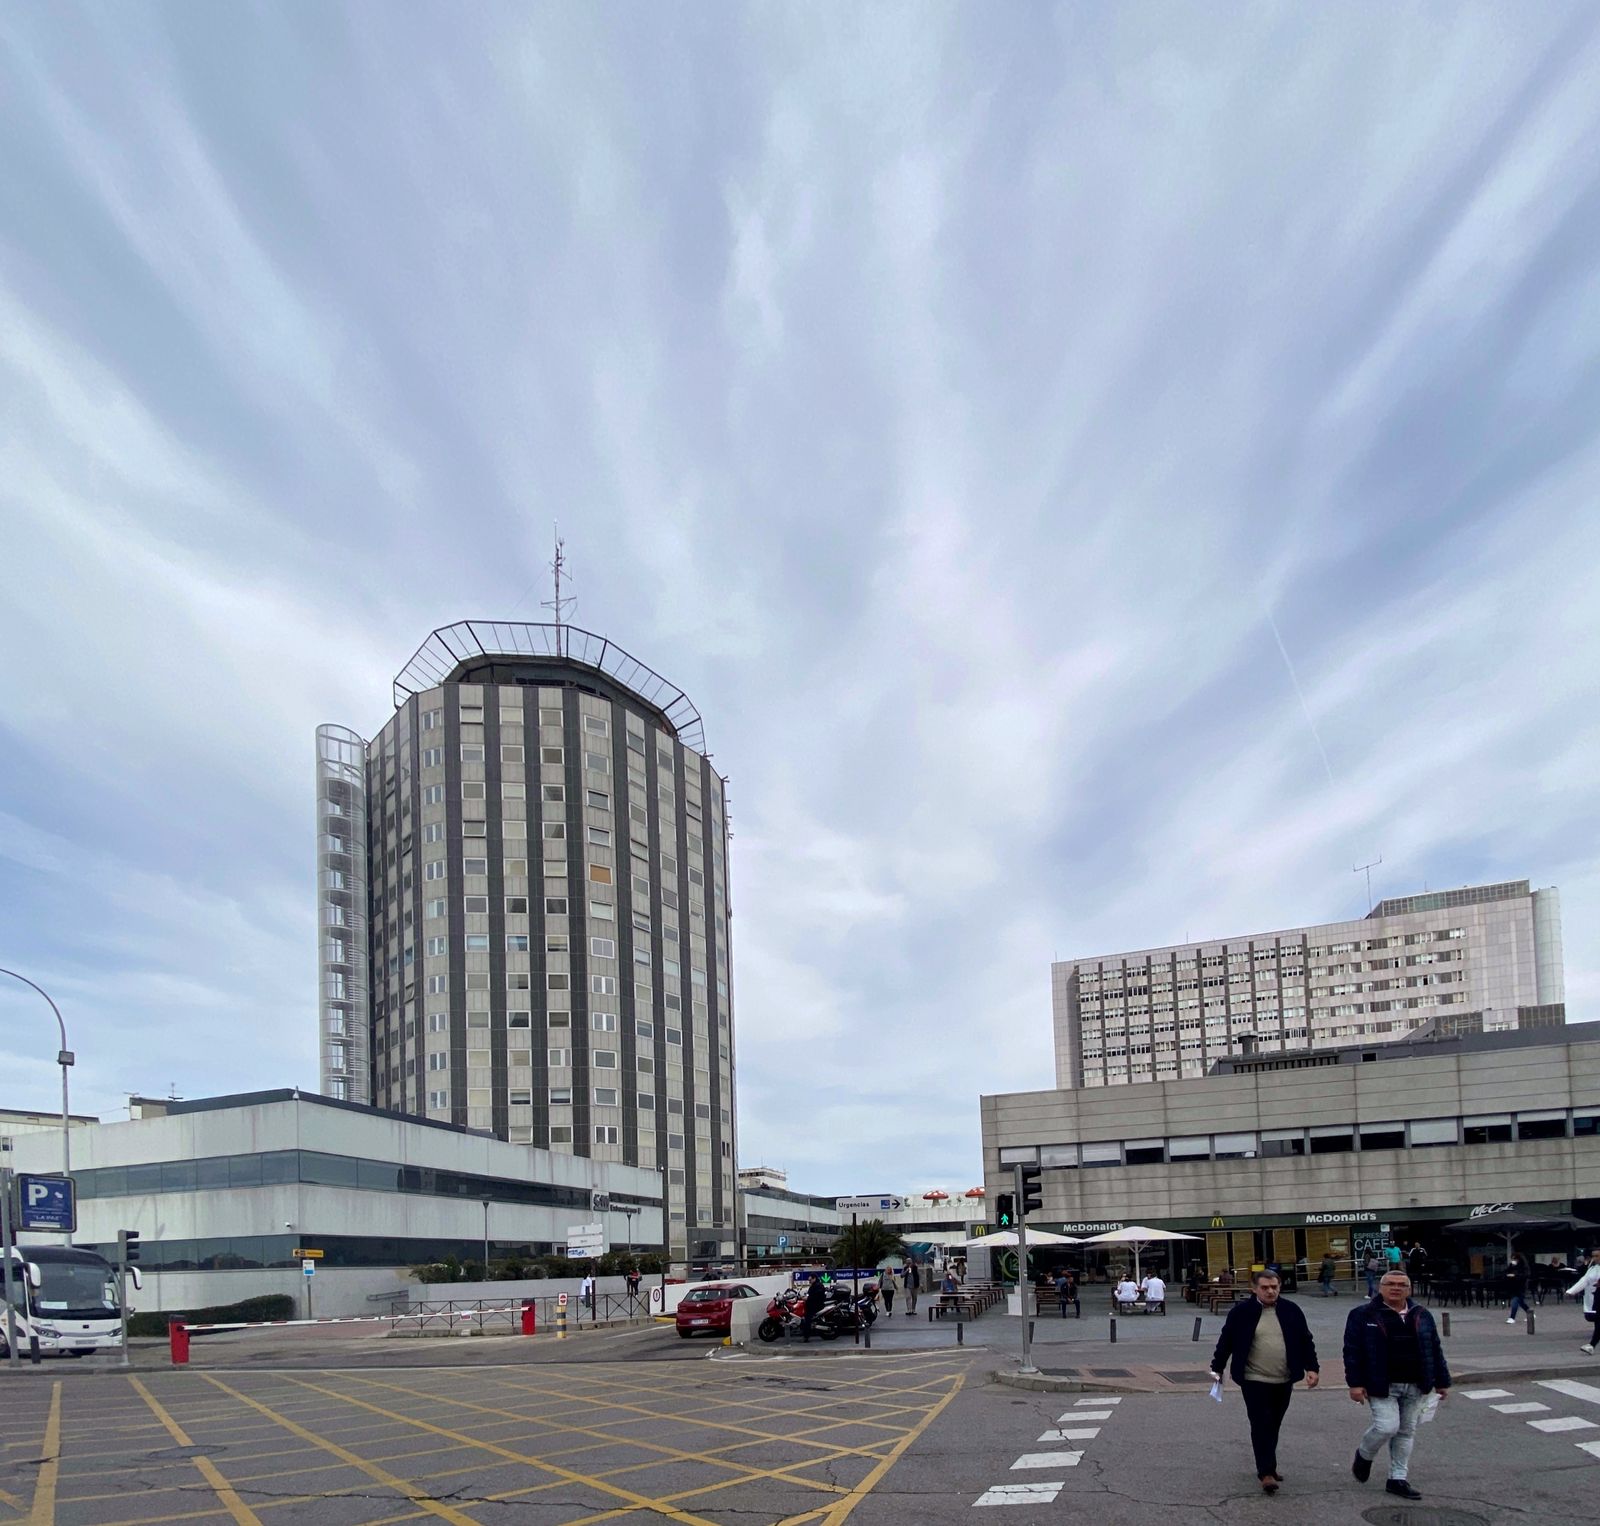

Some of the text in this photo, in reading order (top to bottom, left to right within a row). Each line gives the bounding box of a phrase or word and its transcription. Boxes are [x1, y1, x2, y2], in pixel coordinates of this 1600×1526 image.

[28, 1183, 48, 1206] P
[838, 1201, 870, 1209] Urgencias
[1305, 1212, 1377, 1223] McDonald's
[1063, 1222, 1124, 1232] McDonald's
[779, 1236, 787, 1246] P
[795, 1272, 801, 1280] P
